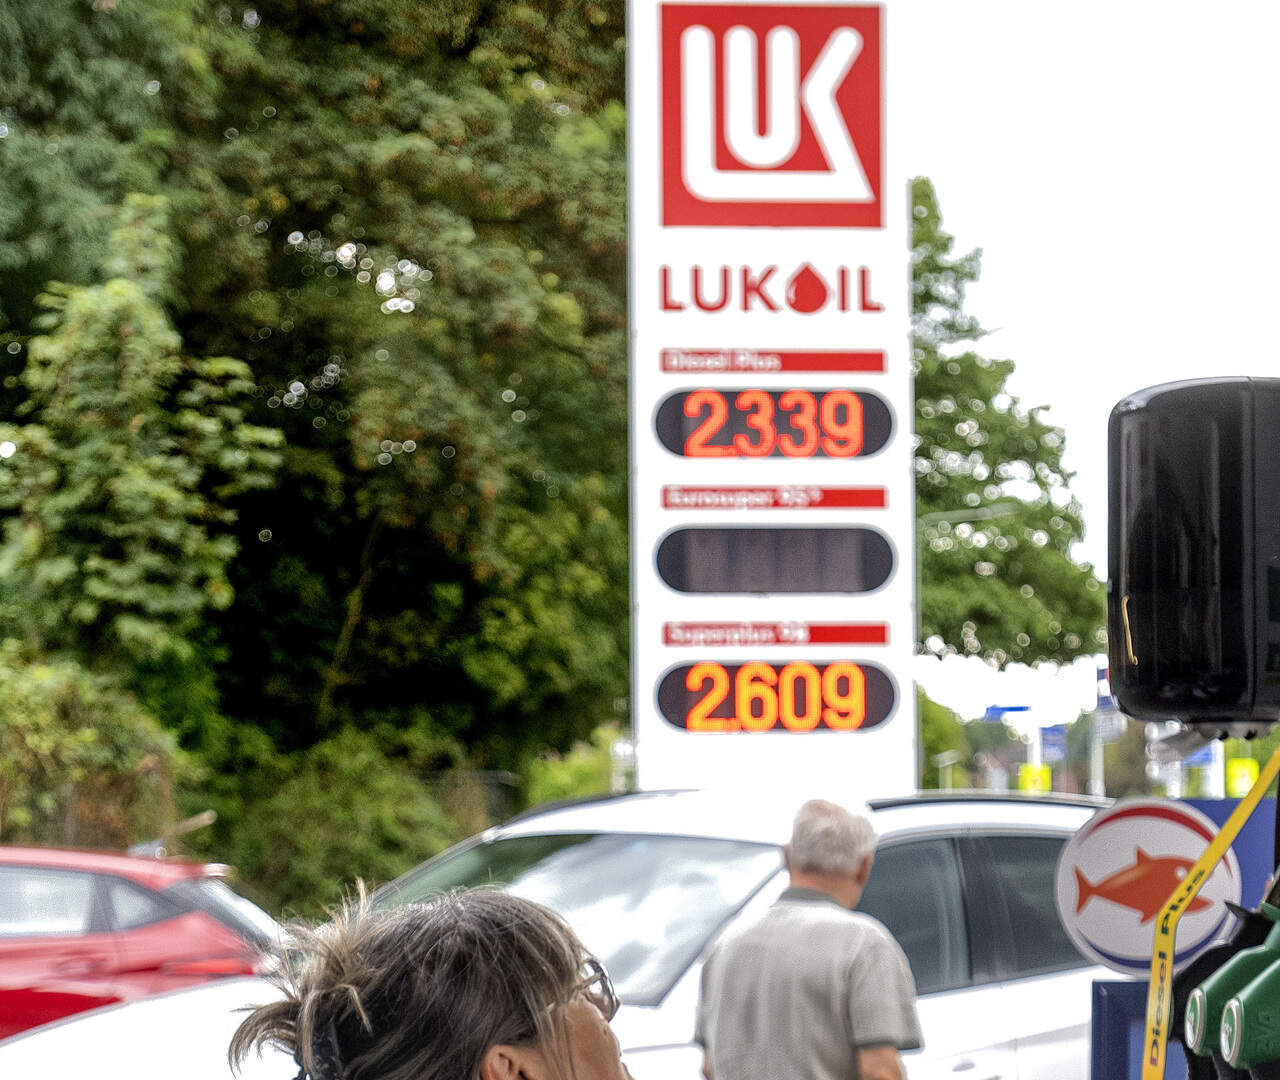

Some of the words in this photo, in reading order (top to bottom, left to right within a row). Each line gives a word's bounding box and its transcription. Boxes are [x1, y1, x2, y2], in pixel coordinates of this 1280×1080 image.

[680, 25, 876, 203] LUK
[659, 262, 885, 315] LUKOIL
[1149, 950, 1169, 1067] Diesel
[1161, 868, 1206, 936] Plus
